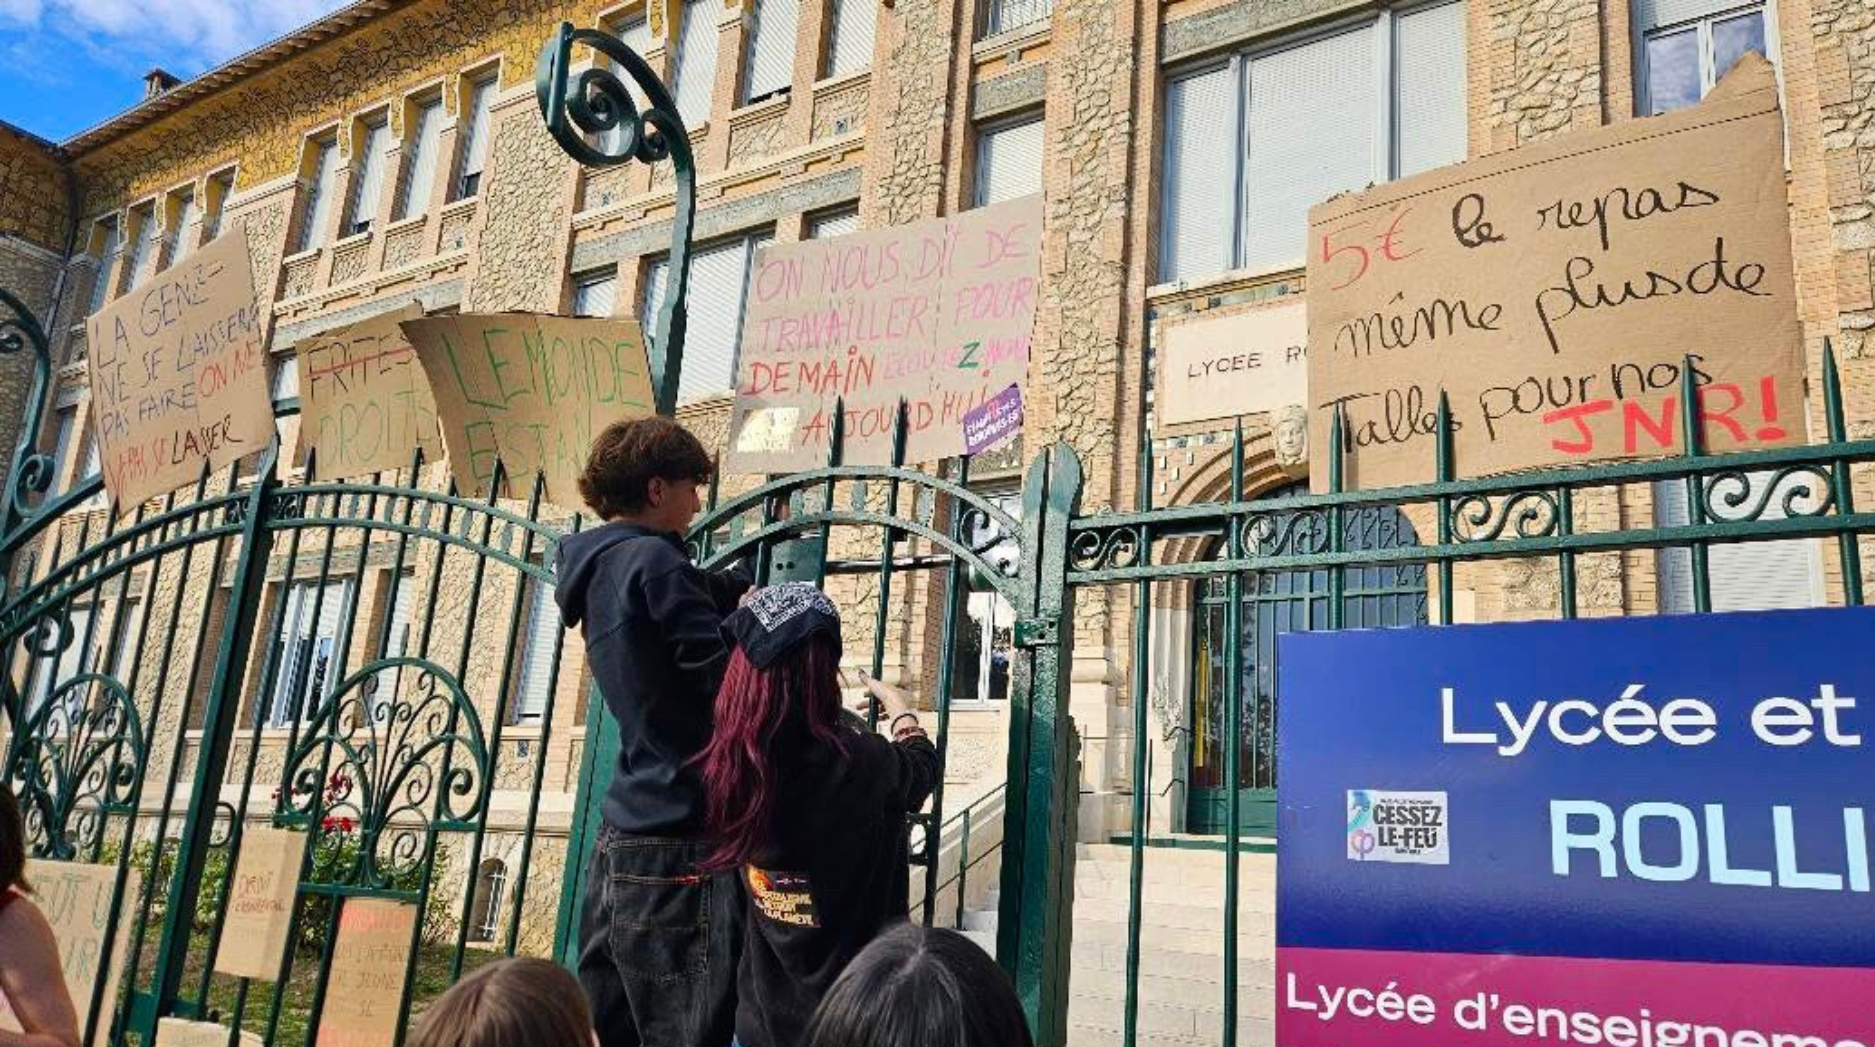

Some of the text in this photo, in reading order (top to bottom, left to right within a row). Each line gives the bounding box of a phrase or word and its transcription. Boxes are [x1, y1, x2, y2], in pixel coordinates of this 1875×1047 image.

[757, 257, 804, 303] ON
[820, 240, 900, 294] NOUS
[975, 221, 1029, 269] DE
[1320, 180, 1720, 291] 5€ le repas
[95, 315, 131, 369] LA
[759, 276, 1035, 352] TRAVAILLER POUR
[1334, 291, 1503, 358] même
[97, 360, 131, 411] NE
[141, 345, 164, 389] SE
[199, 340, 261, 399] ON NE
[1187, 344, 1308, 379] LYCEE R
[138, 380, 198, 423] FAIRE
[1479, 372, 1598, 442] pour
[1441, 684, 1863, 757] Lycée et
[1373, 804, 1443, 827] CESSEZ
[1378, 826, 1438, 849] LE-FEU
[1549, 799, 1871, 893] ROLLI
[1286, 972, 1872, 1047] Lycée d'enseigne
